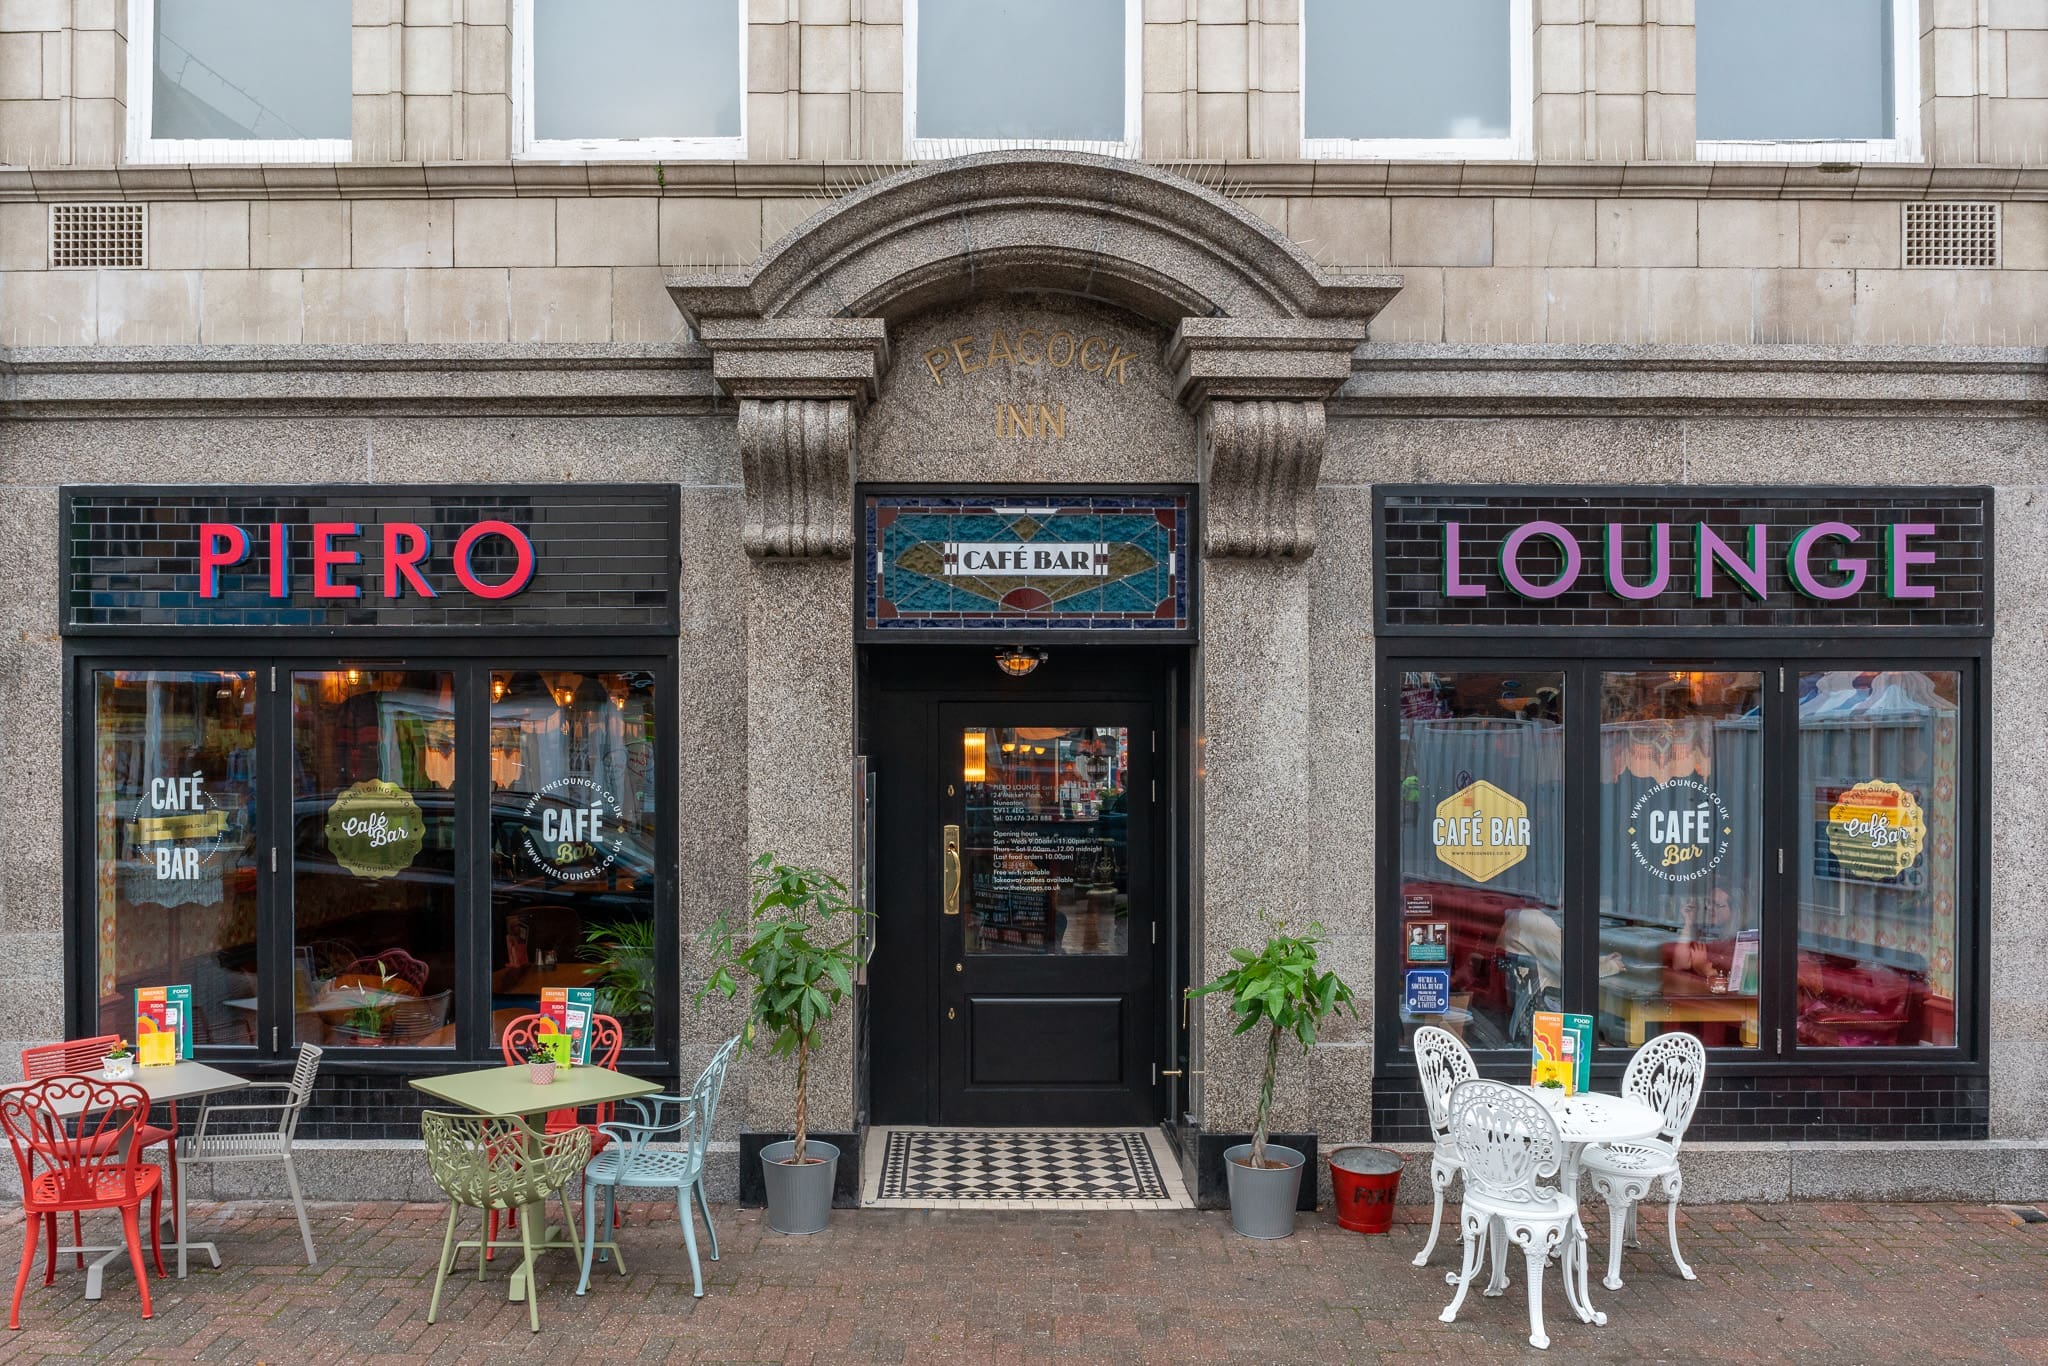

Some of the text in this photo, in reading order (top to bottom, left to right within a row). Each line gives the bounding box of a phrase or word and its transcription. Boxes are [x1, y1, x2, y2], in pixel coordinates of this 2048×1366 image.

[923, 328, 1137, 385] PEACOCK
[996, 402, 1065, 438] INN
[199, 519, 536, 600] PIERO
[963, 546, 1090, 570] CAFÉ BAR
[1441, 520, 1936, 600] LOUNGE
[151, 770, 204, 810] CAFÉ
[523, 777, 624, 818] WWW.THELOUNGES.CO.UK
[1630, 779, 1730, 820] WWW.THELOUNGES.CO.UK
[341, 811, 389, 837] Café
[369, 827, 409, 847] Bar
[542, 799, 604, 842] CAFÉ
[993, 830, 1020, 838] Opening
[1432, 810, 1531, 846] CAFÉ BAR
[1649, 801, 1710, 844] CAFÉ
[1843, 812, 1890, 838] Café
[1871, 826, 1910, 848] Bar
[156, 847, 200, 880] BAR
[523, 839, 623, 880] WWW.THELOUNGES.CO.UK
[555, 842, 597, 865] Bar
[1630, 840, 1729, 882] WWW.THELOUNGES.CO.UK
[1661, 844, 1703, 867] Bar
[993, 884, 1061, 892] www.thelounges.co.uk
